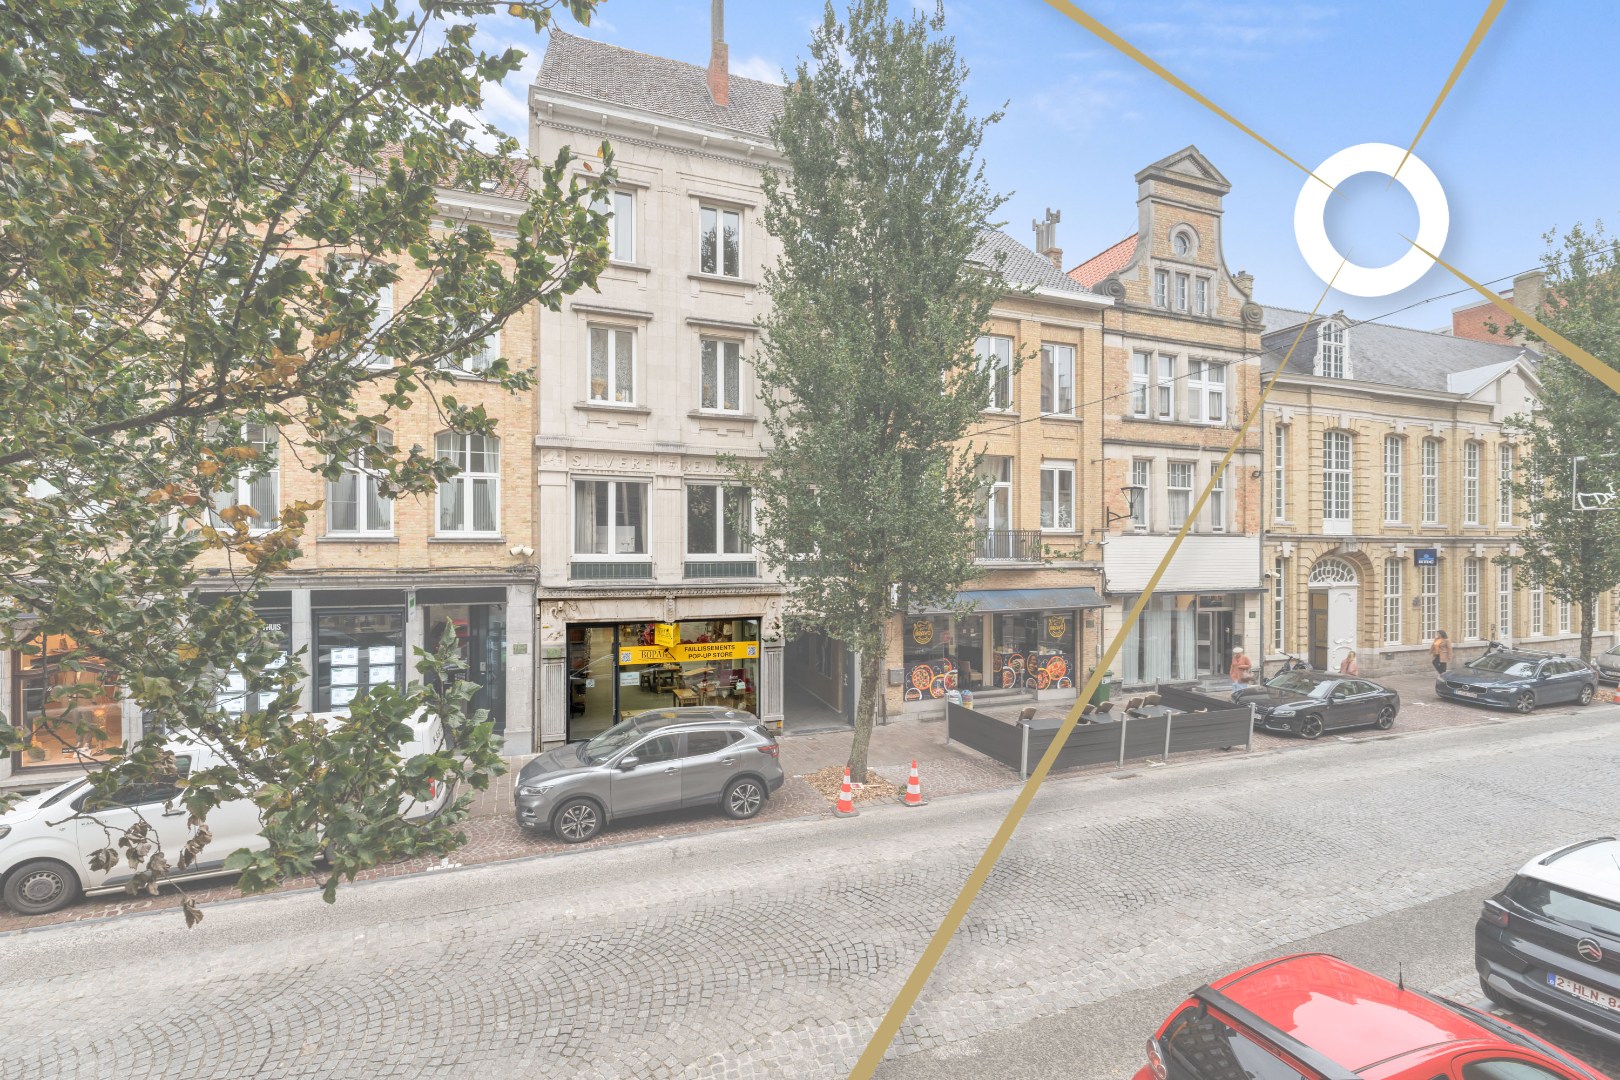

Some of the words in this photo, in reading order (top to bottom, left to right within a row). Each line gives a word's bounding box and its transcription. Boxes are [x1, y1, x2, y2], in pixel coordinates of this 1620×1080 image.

[572, 453, 653, 470] SILVERE
[684, 644, 735, 652] FAILLISSEMENTS
[1557, 977, 1620, 1008] 2-HLN-8
